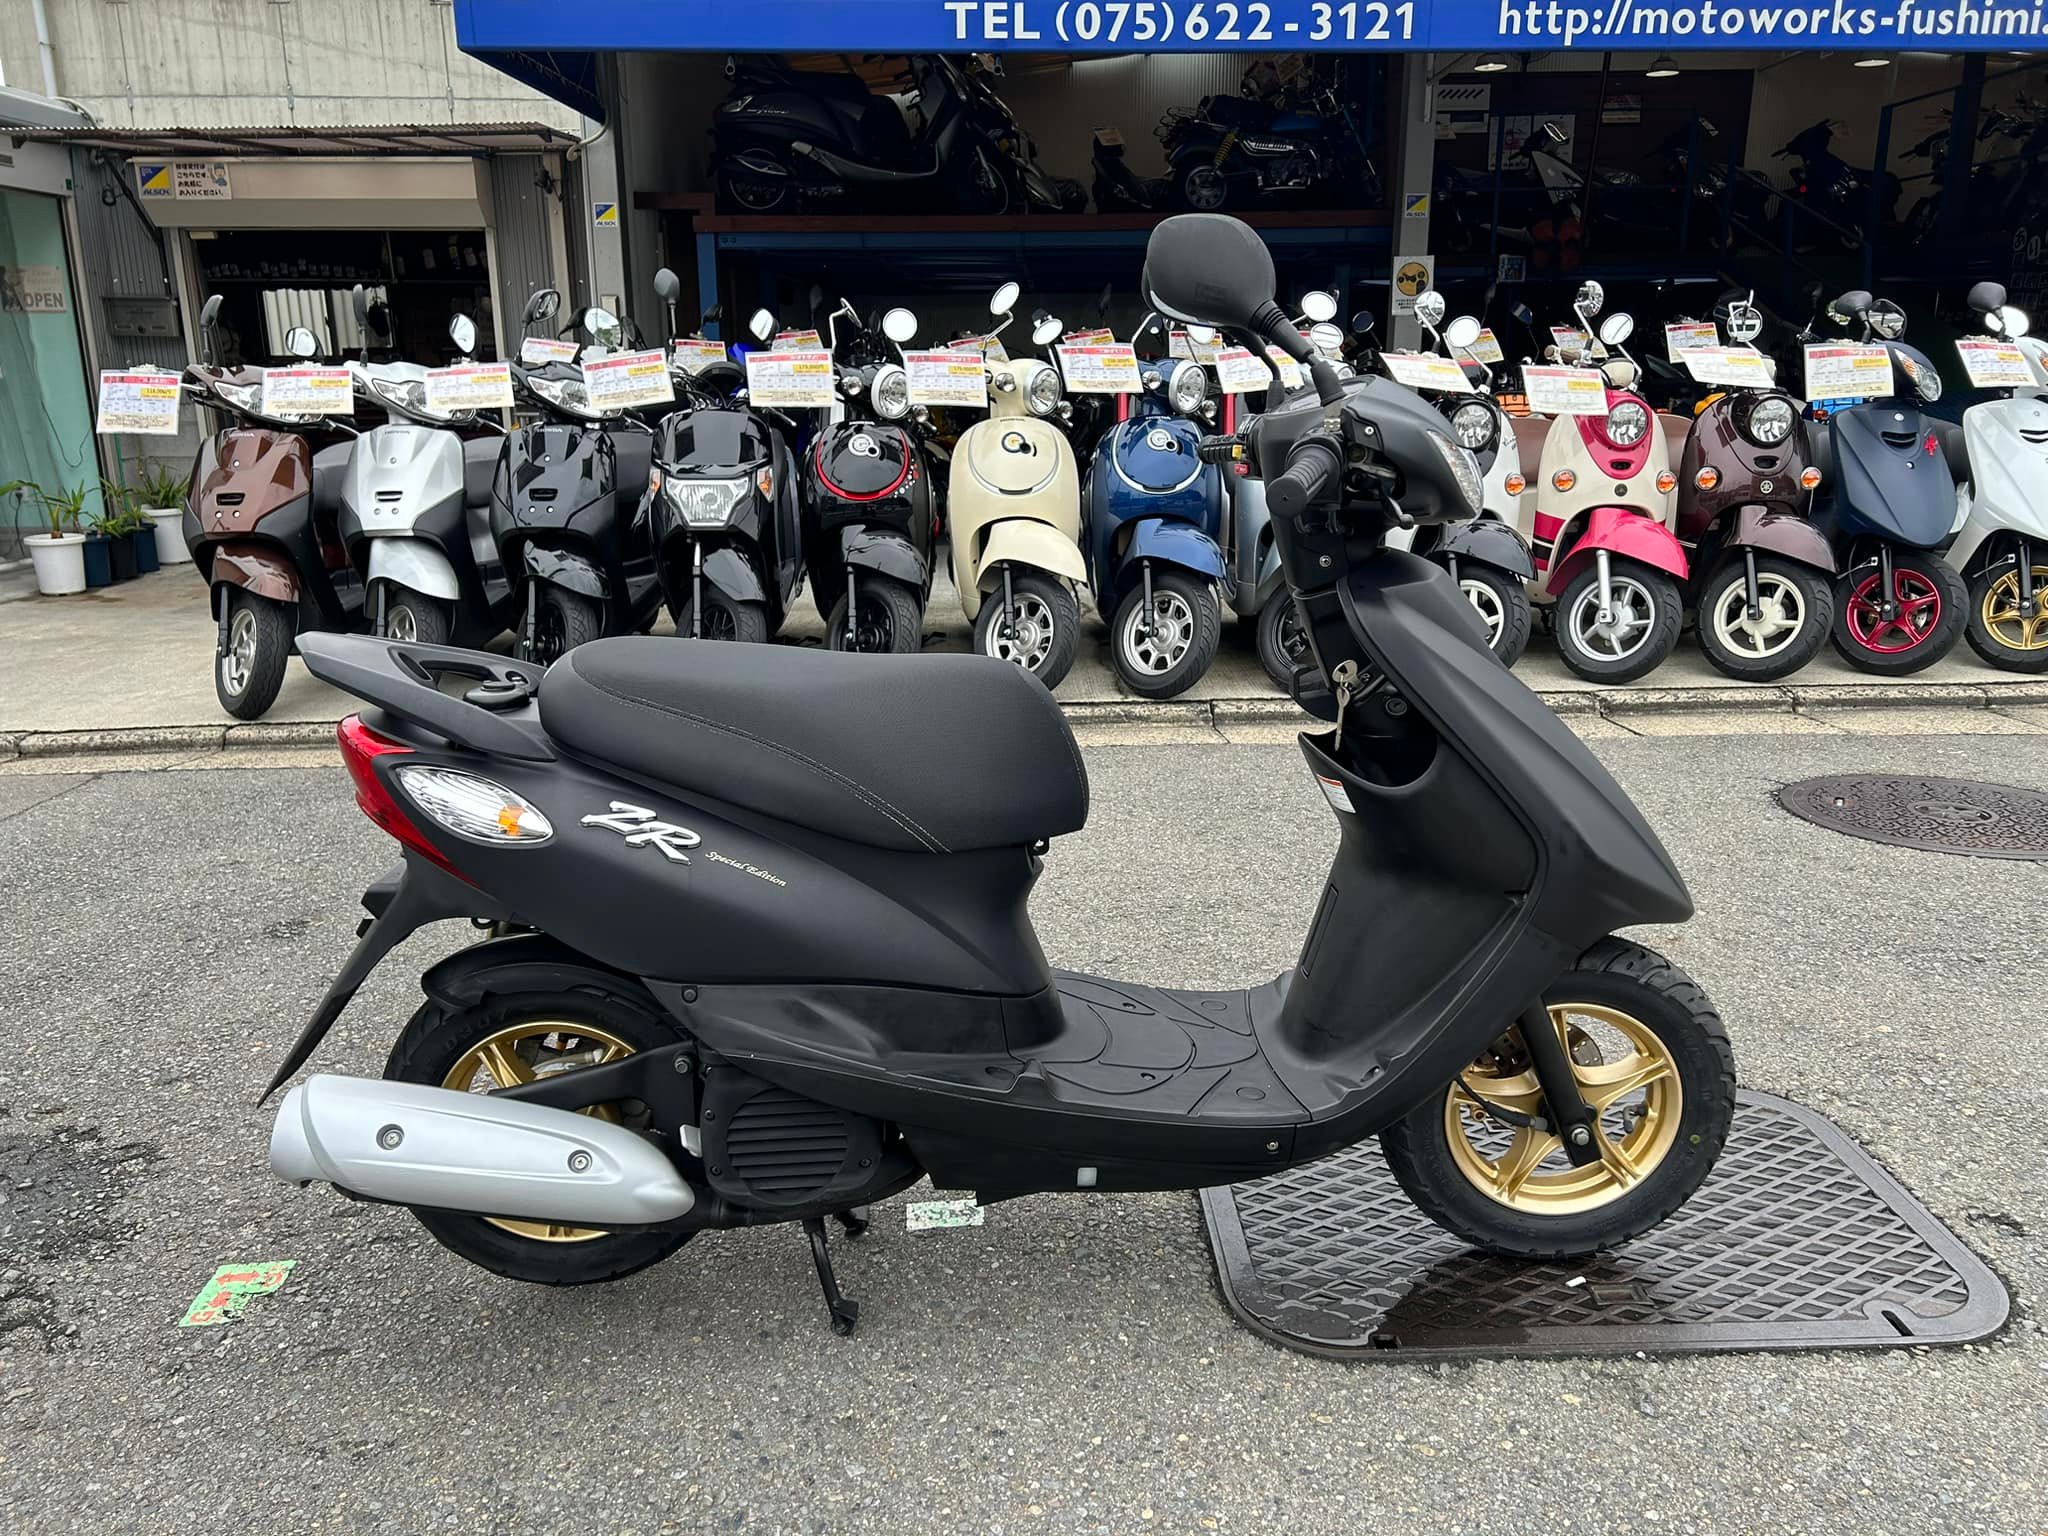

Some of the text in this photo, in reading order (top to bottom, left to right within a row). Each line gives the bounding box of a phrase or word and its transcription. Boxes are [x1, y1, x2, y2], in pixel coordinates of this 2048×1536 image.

[944, 2, 1041, 40] TEL
[24, 292, 64, 308] OPEN
[579, 800, 702, 865] ZR
[705, 851, 787, 887] Special Edition
